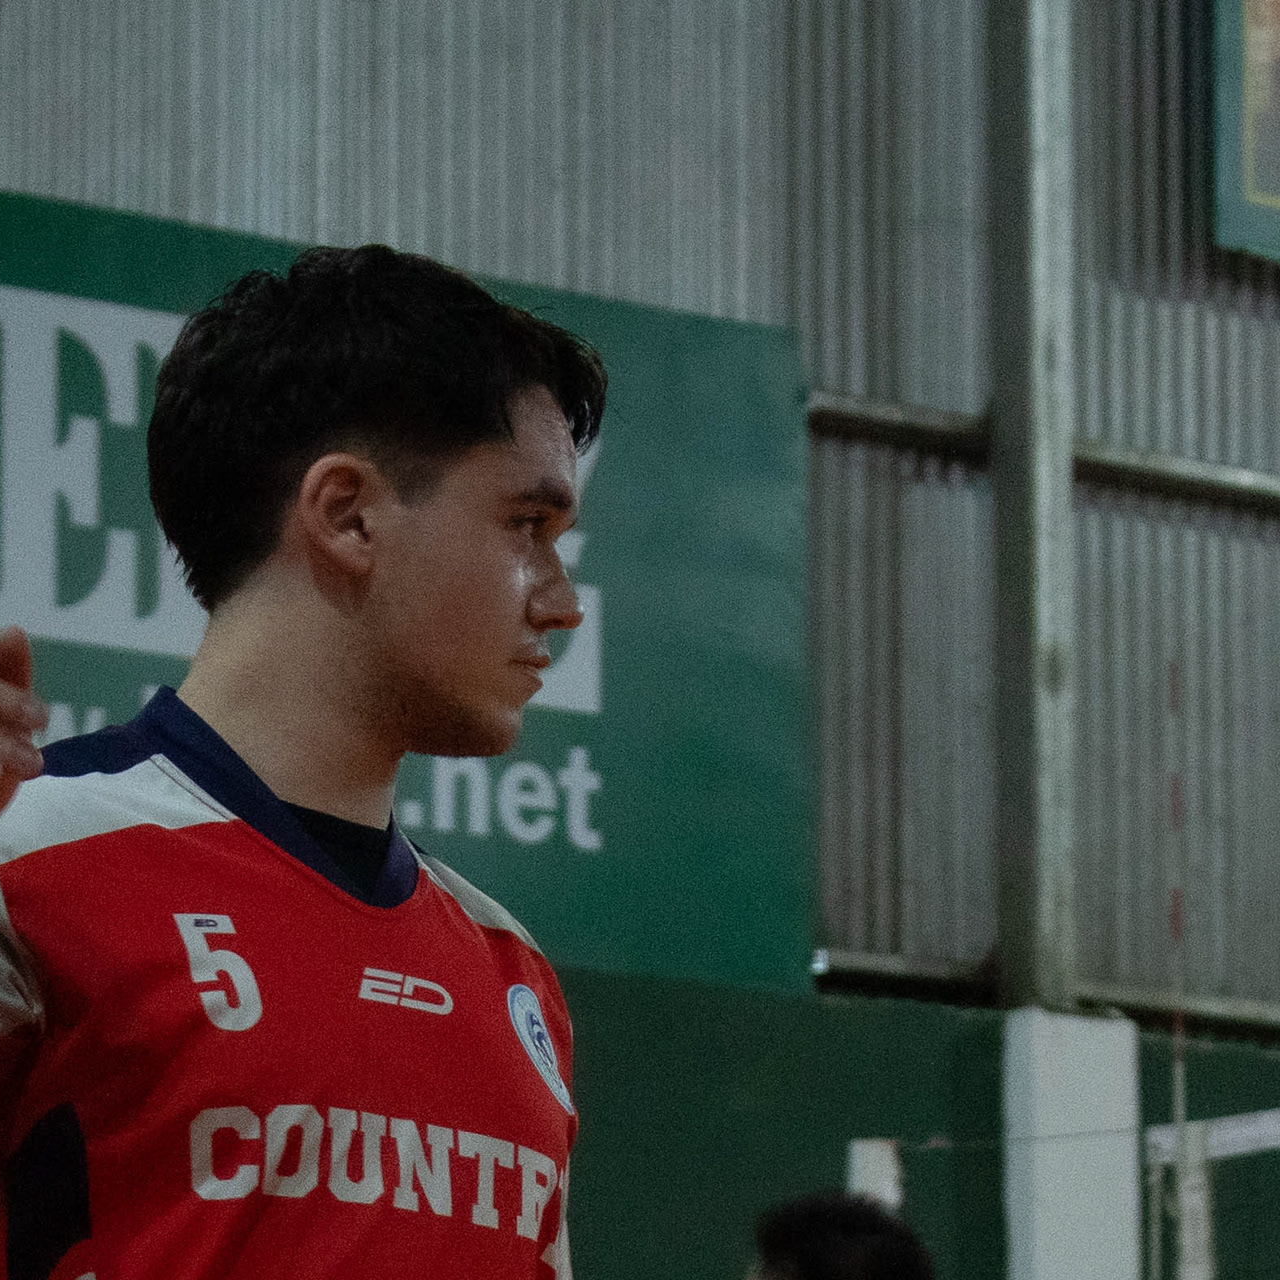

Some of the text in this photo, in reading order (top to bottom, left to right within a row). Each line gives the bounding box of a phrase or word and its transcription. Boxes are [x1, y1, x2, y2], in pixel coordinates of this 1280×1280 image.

[173, 912, 263, 1032] 5
[359, 967, 454, 1015] ED
[189, 1104, 563, 1242] COUNTR
